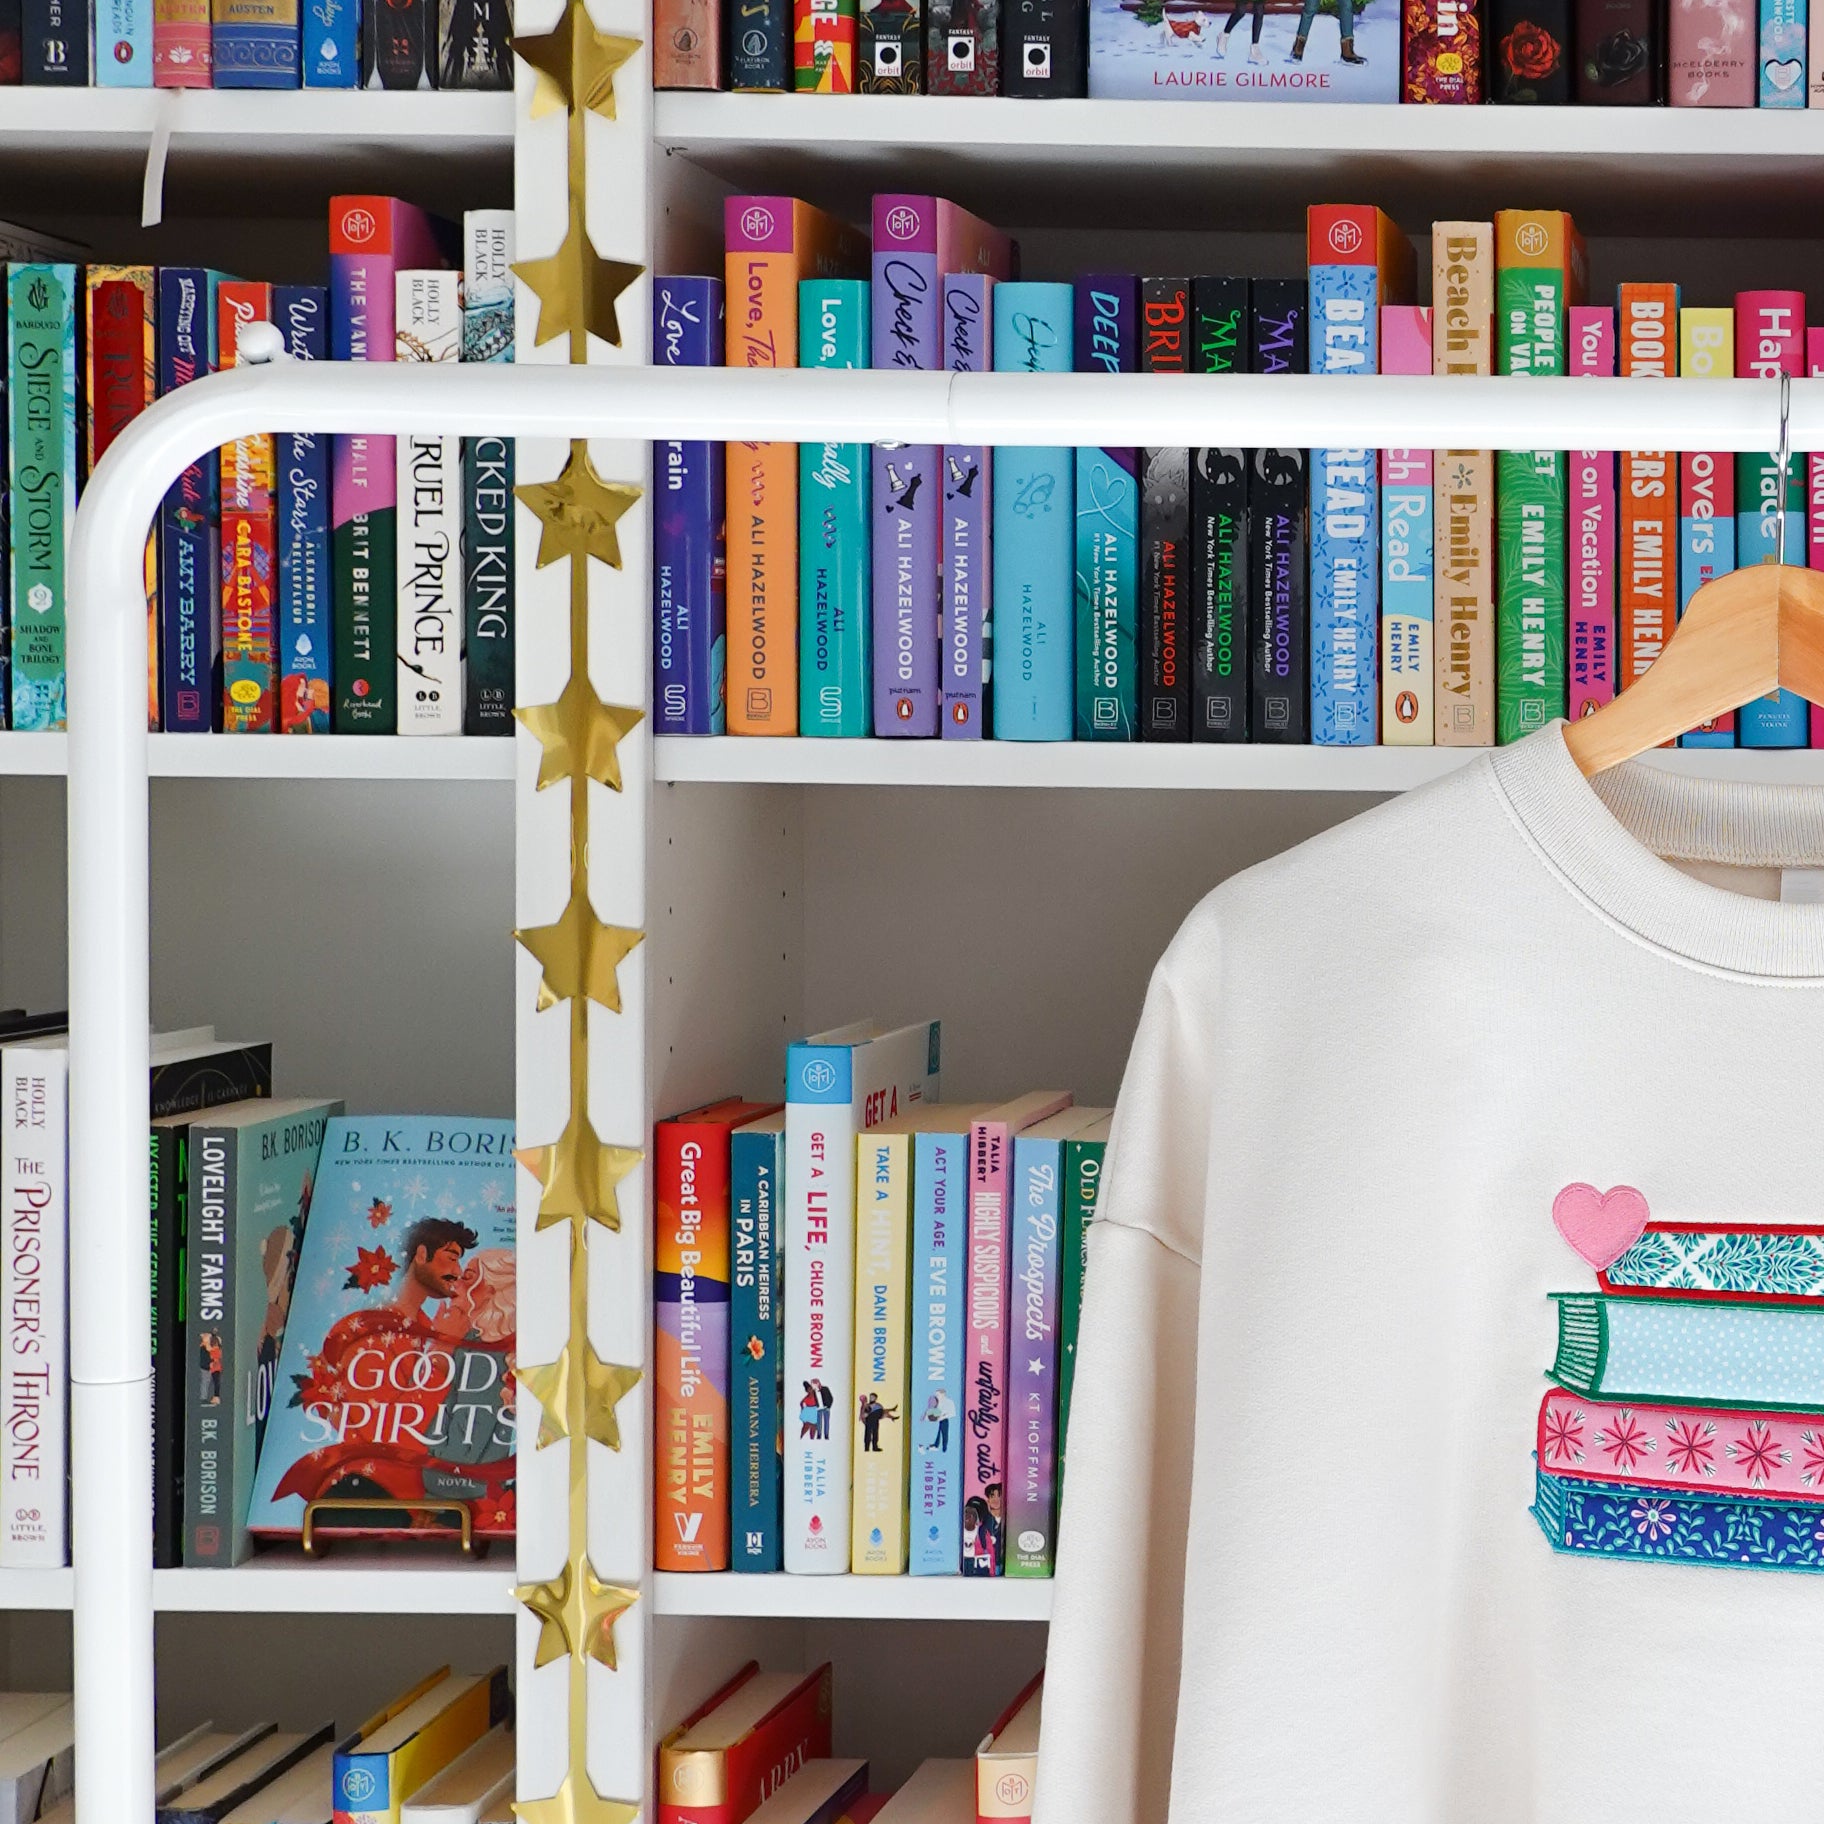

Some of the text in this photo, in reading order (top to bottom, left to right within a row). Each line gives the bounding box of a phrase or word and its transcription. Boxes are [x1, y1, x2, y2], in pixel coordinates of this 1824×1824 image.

[228, 3, 275, 14] AUSTEN
[1154, 71, 1330, 88] LAURIE GILMORE
[19, 342, 59, 571] SIEGE AND STORM
[179, 538, 197, 686] AMY BARRY
[751, 515, 766, 679] ALI HAZELWOOD
[1334, 559, 1358, 693] EMILY HENRY
[15, 1158, 46, 1175] THE
[200, 1137, 225, 1321] LOVELIGHT FARMS
[677, 1141, 702, 1398] Great Big Beautiful Life
[12, 1181, 52, 1480] PRISONER'S THRONE
[347, 1350, 499, 1392] GOOD
[301, 1402, 516, 1445] SPIRITS
[200, 1450, 216, 1514] BORISON
[437, 1478, 475, 1487] NOVEL
